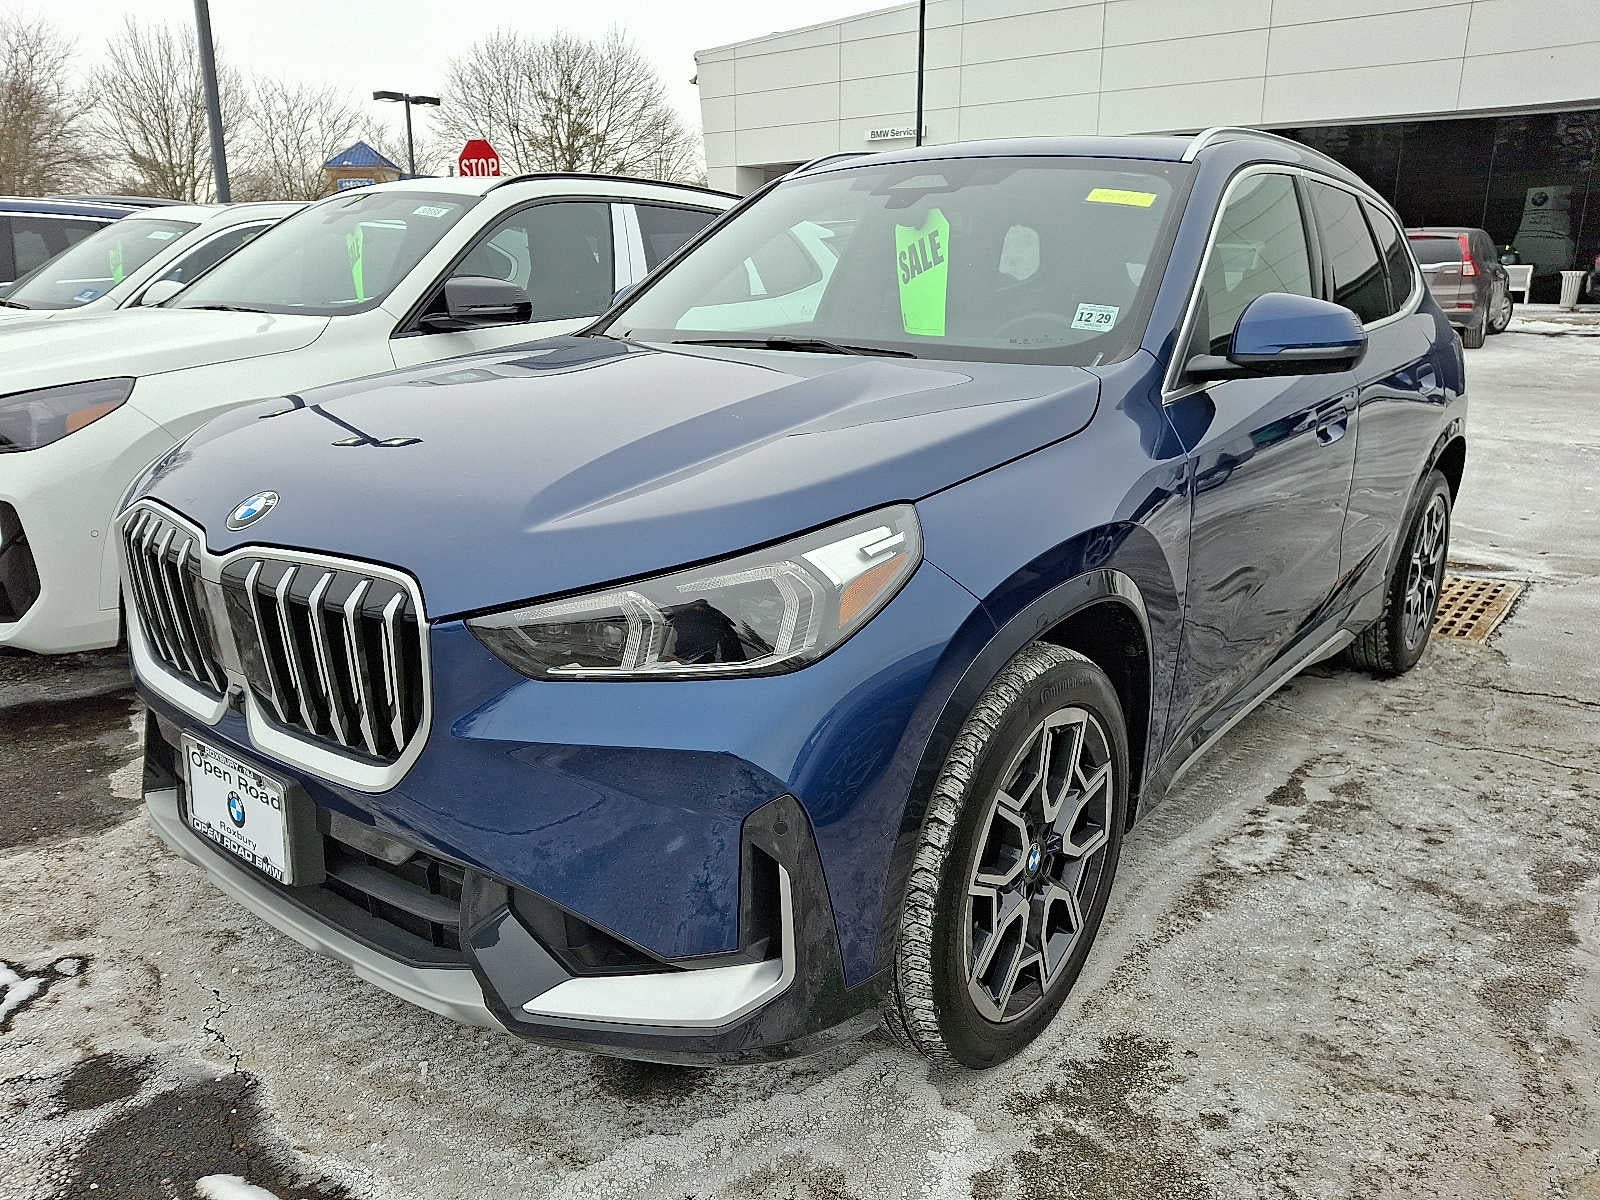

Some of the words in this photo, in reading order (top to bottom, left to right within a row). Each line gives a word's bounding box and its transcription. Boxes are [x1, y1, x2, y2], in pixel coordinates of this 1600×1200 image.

[870, 129, 889, 139] BMW
[461, 158, 498, 177] STOP
[899, 230, 944, 284] SALE
[1077, 311, 1094, 323] 12
[1096, 313, 1112, 324] 29
[191, 751, 232, 785] Open
[238, 776, 281, 811] Road
[193, 820, 221, 844] OPEN
[223, 837, 253, 862] ROAD
[255, 857, 282, 881] BMW
[219, 820, 257, 851] Roxbury
